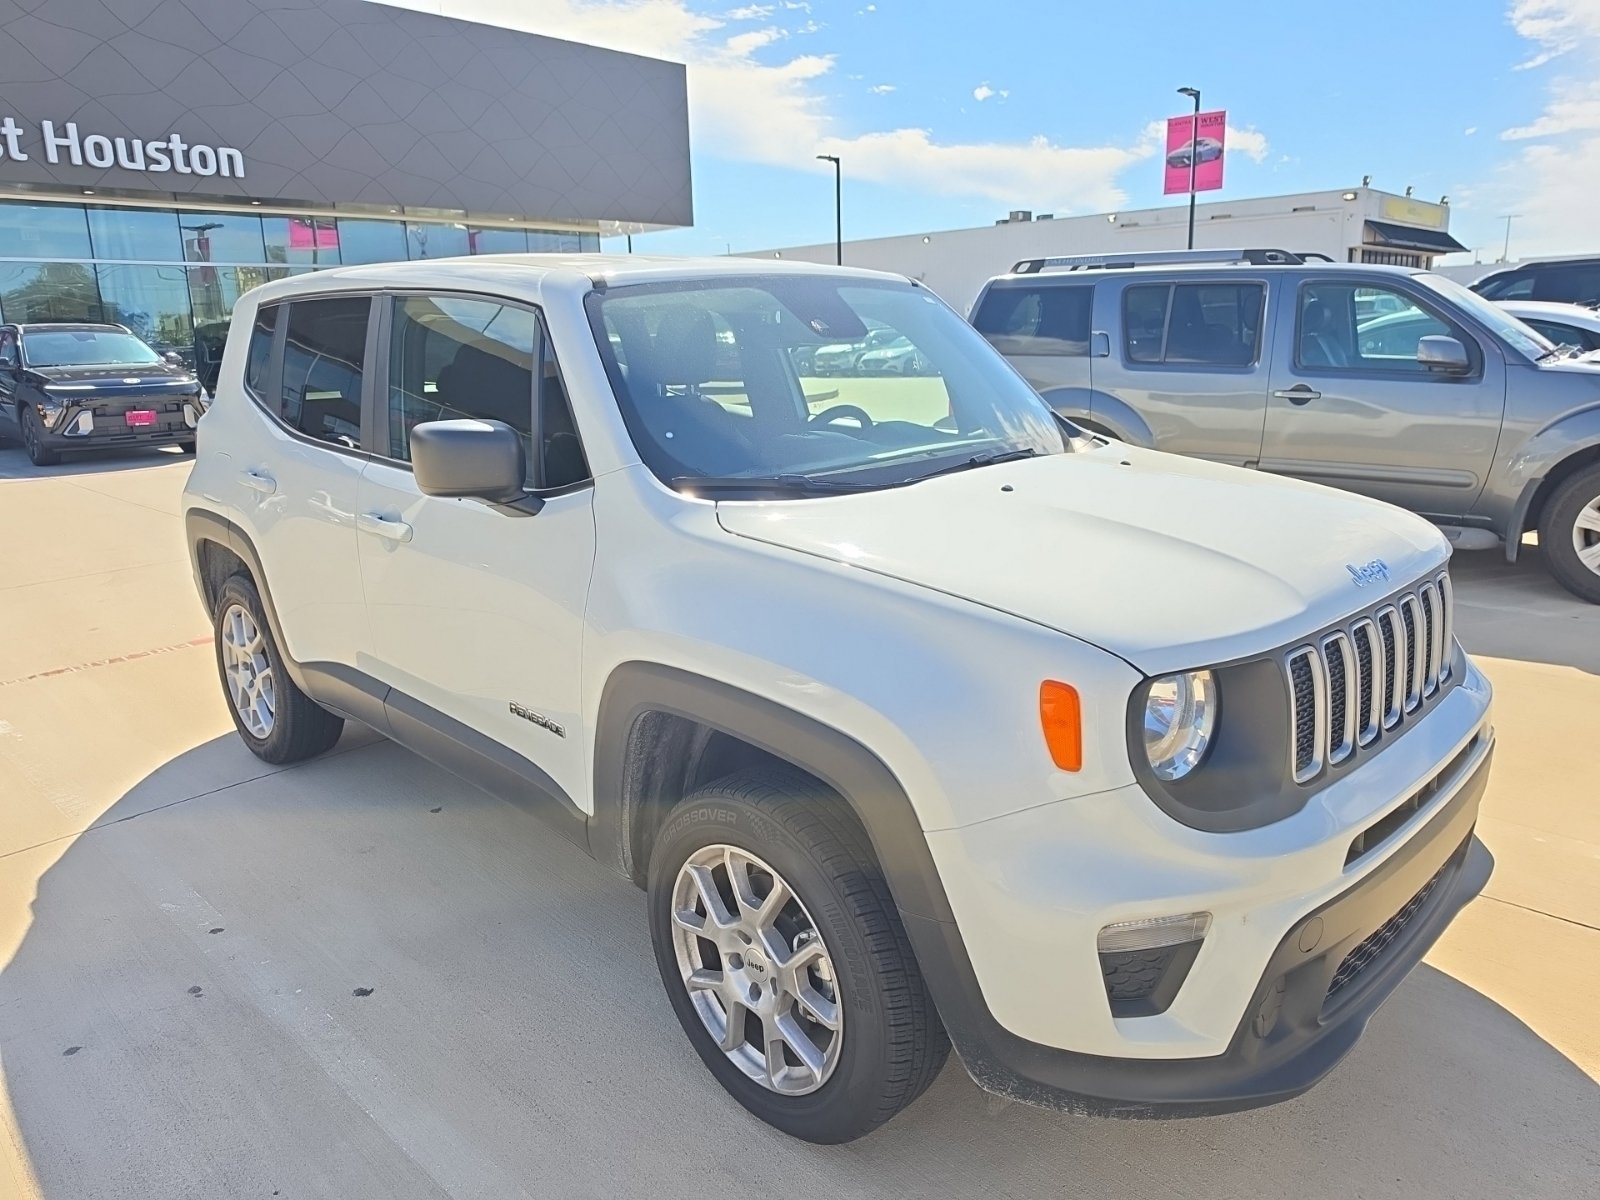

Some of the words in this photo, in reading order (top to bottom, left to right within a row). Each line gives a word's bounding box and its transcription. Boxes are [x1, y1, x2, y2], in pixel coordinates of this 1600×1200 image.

[1200, 115, 1224, 124] WEST
[0, 117, 28, 161] t
[42, 120, 245, 178] Houston
[1345, 559, 1390, 588] Jeep
[509, 700, 566, 738] RENEGADE
[663, 808, 737, 844] CROSSOVER
[746, 958, 765, 973] Jeep
